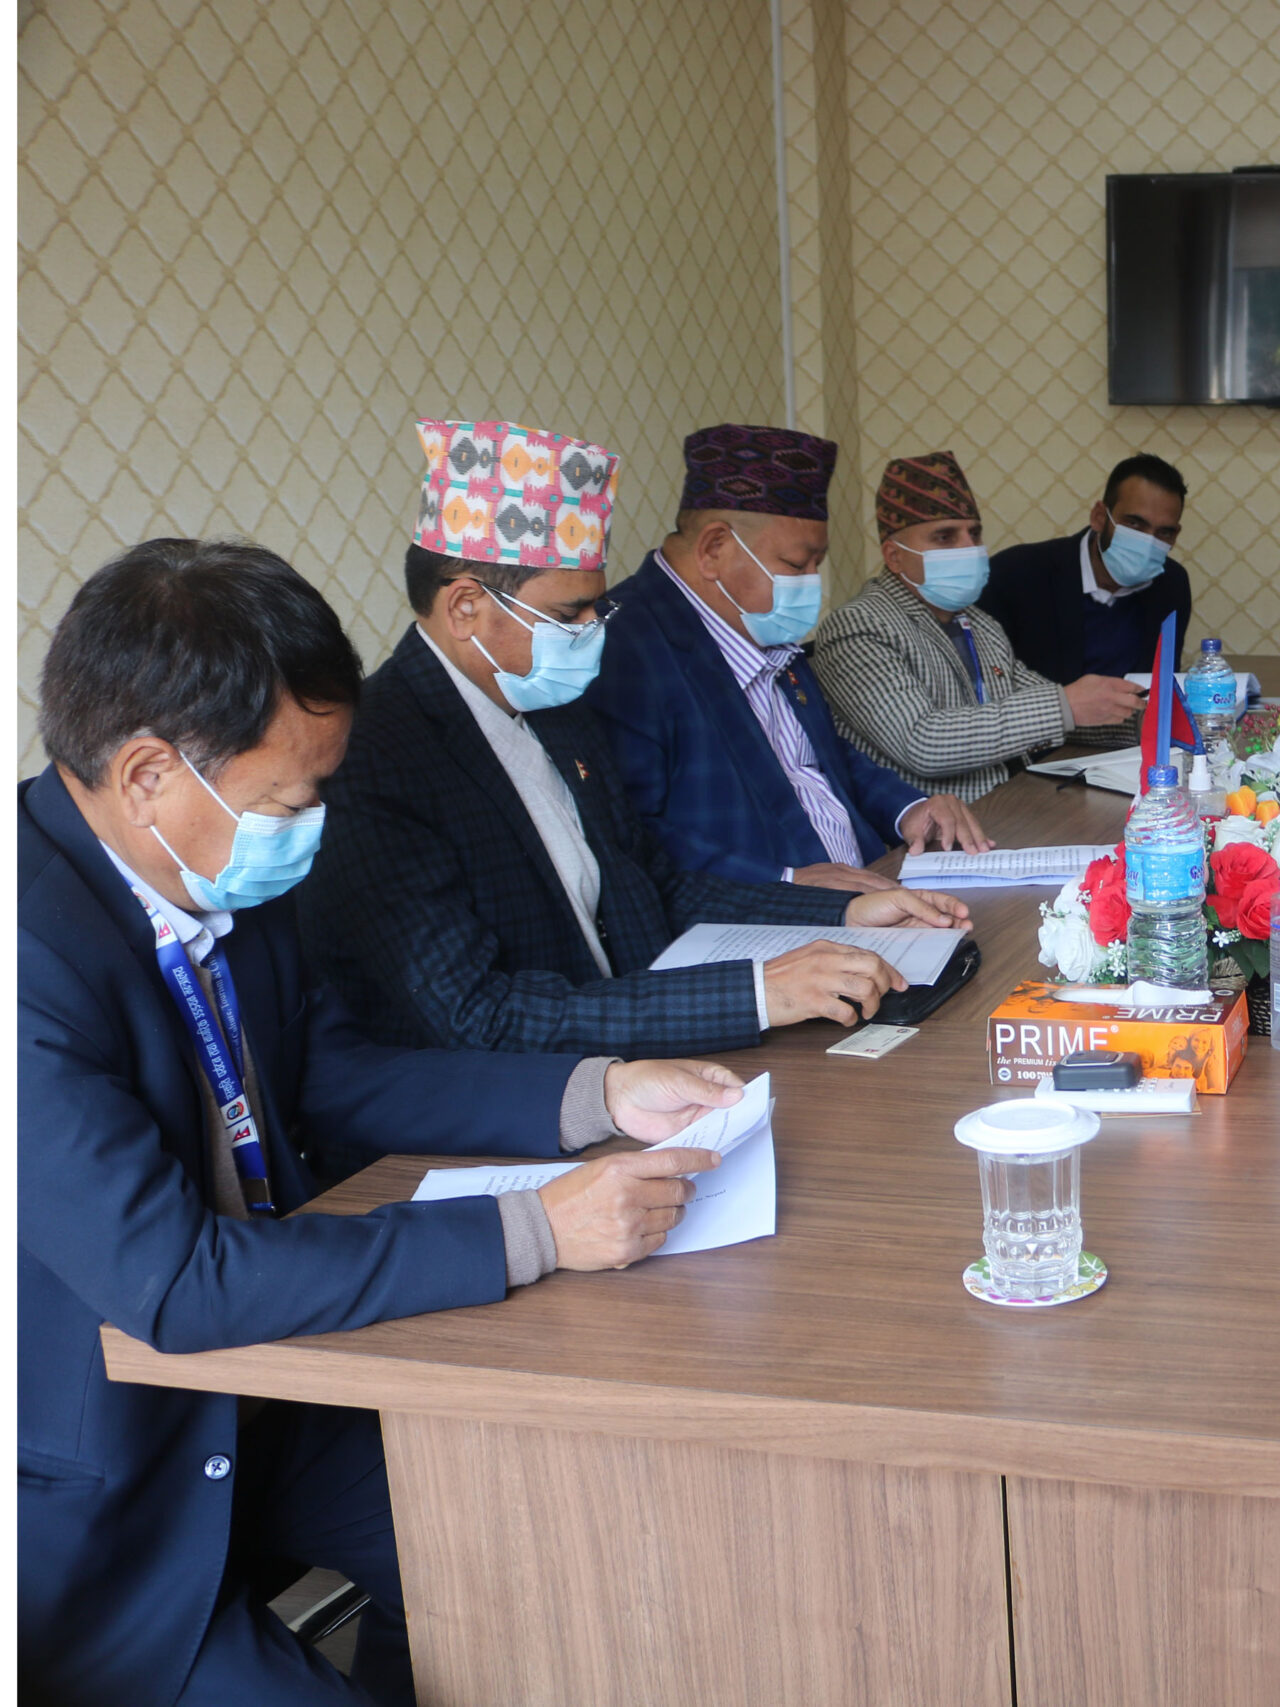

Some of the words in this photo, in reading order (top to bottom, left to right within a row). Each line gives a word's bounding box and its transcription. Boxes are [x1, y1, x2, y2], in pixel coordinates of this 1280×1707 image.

[1113, 1007, 1222, 1022] PRIME
[996, 1056, 1012, 1065] the
[1013, 1057, 1043, 1066] PREMIUM
[1017, 1070, 1035, 1080] 100
